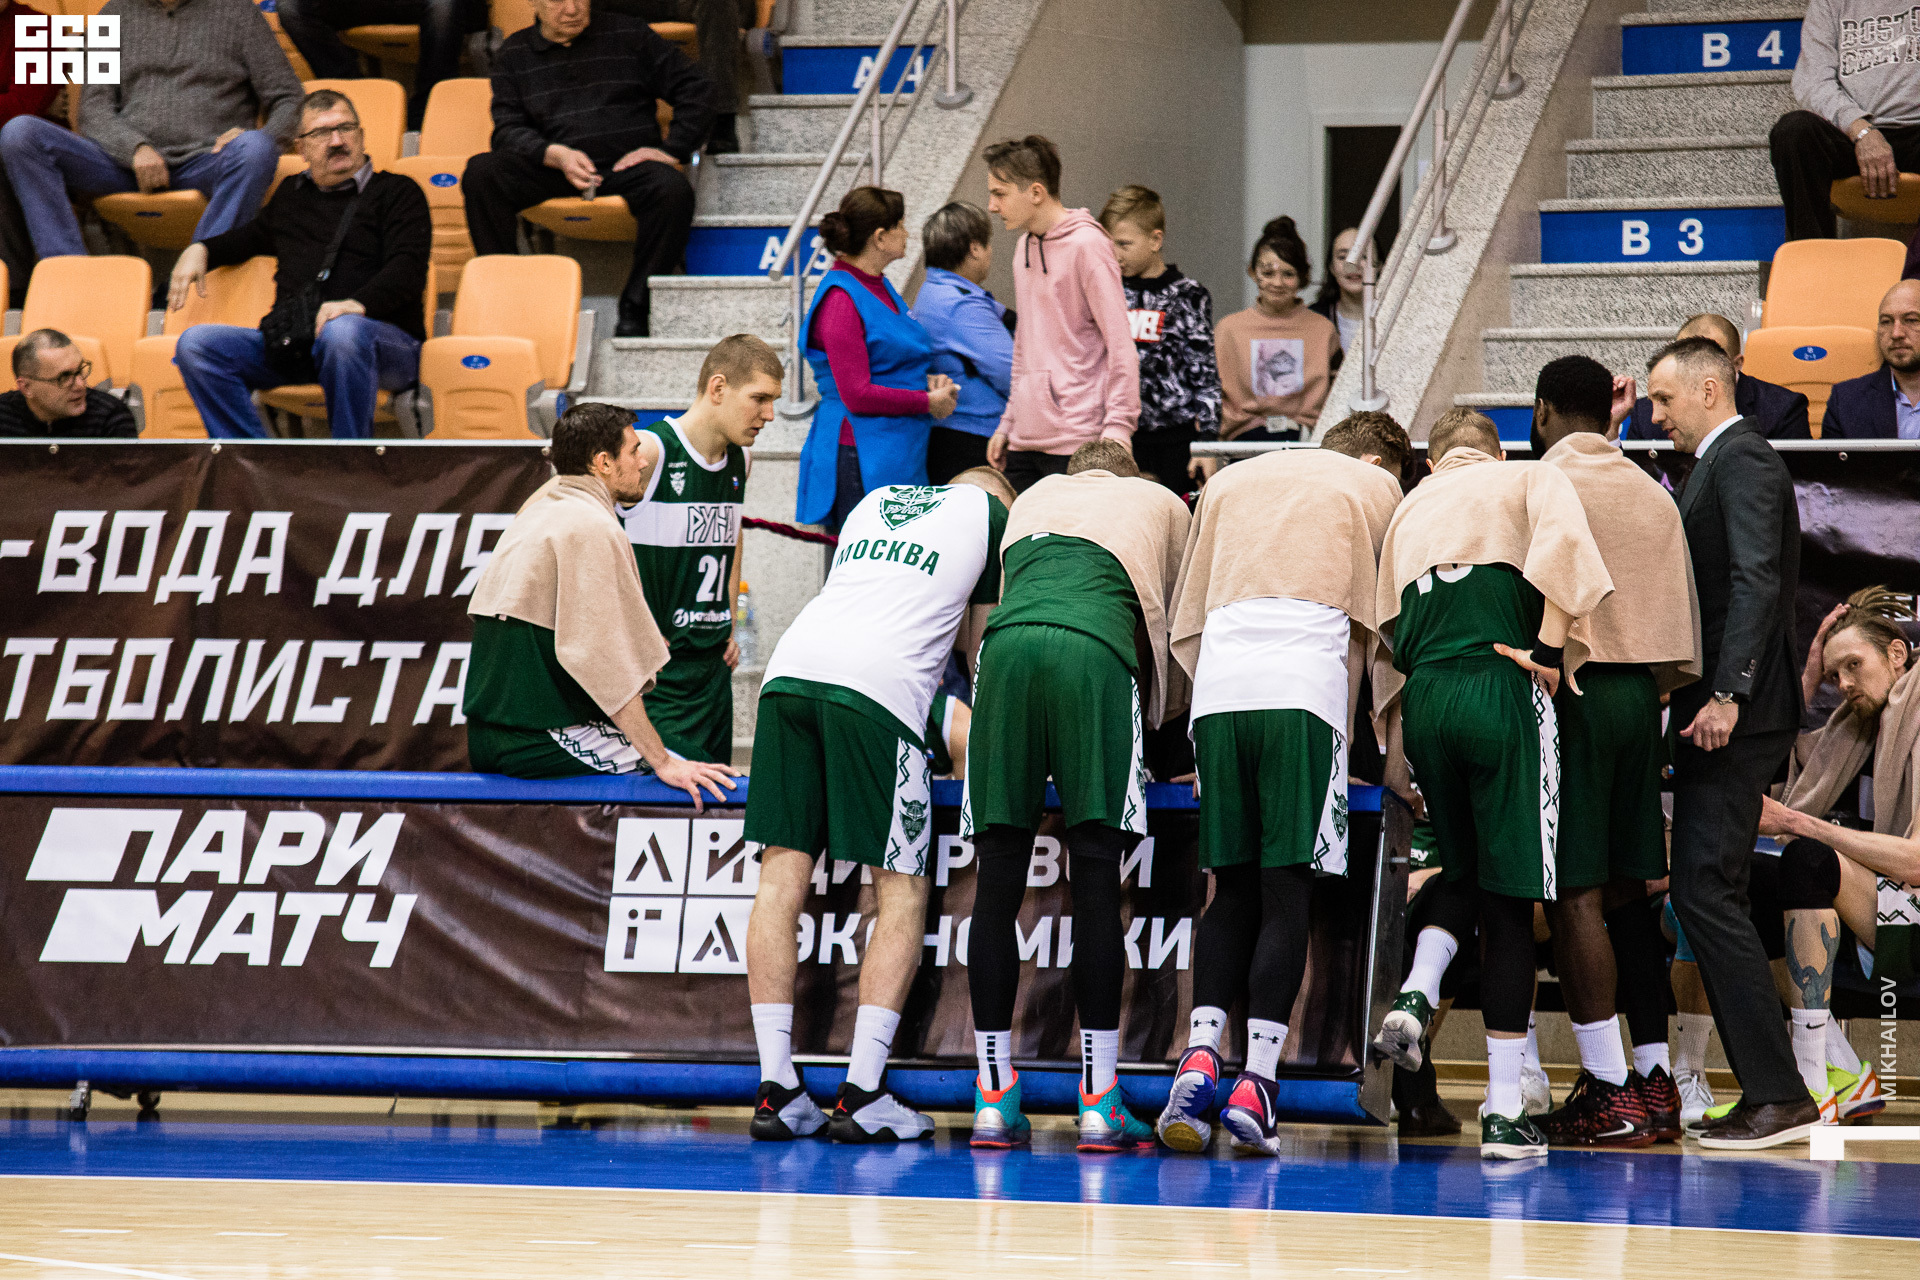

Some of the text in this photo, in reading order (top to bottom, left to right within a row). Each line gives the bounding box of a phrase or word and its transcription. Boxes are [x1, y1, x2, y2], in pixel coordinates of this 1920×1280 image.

[1757, 30, 1784, 64] 4
[1678, 218, 1704, 255] 3
[1127, 310, 1160, 341] VEL
[696, 554, 727, 602] 21
[836, 539, 940, 576] МОСКВА
[3, 637, 473, 727] ТБОЛИСТА
[26, 808, 406, 886] ПАРИ
[39, 889, 418, 968] МАТЧ
